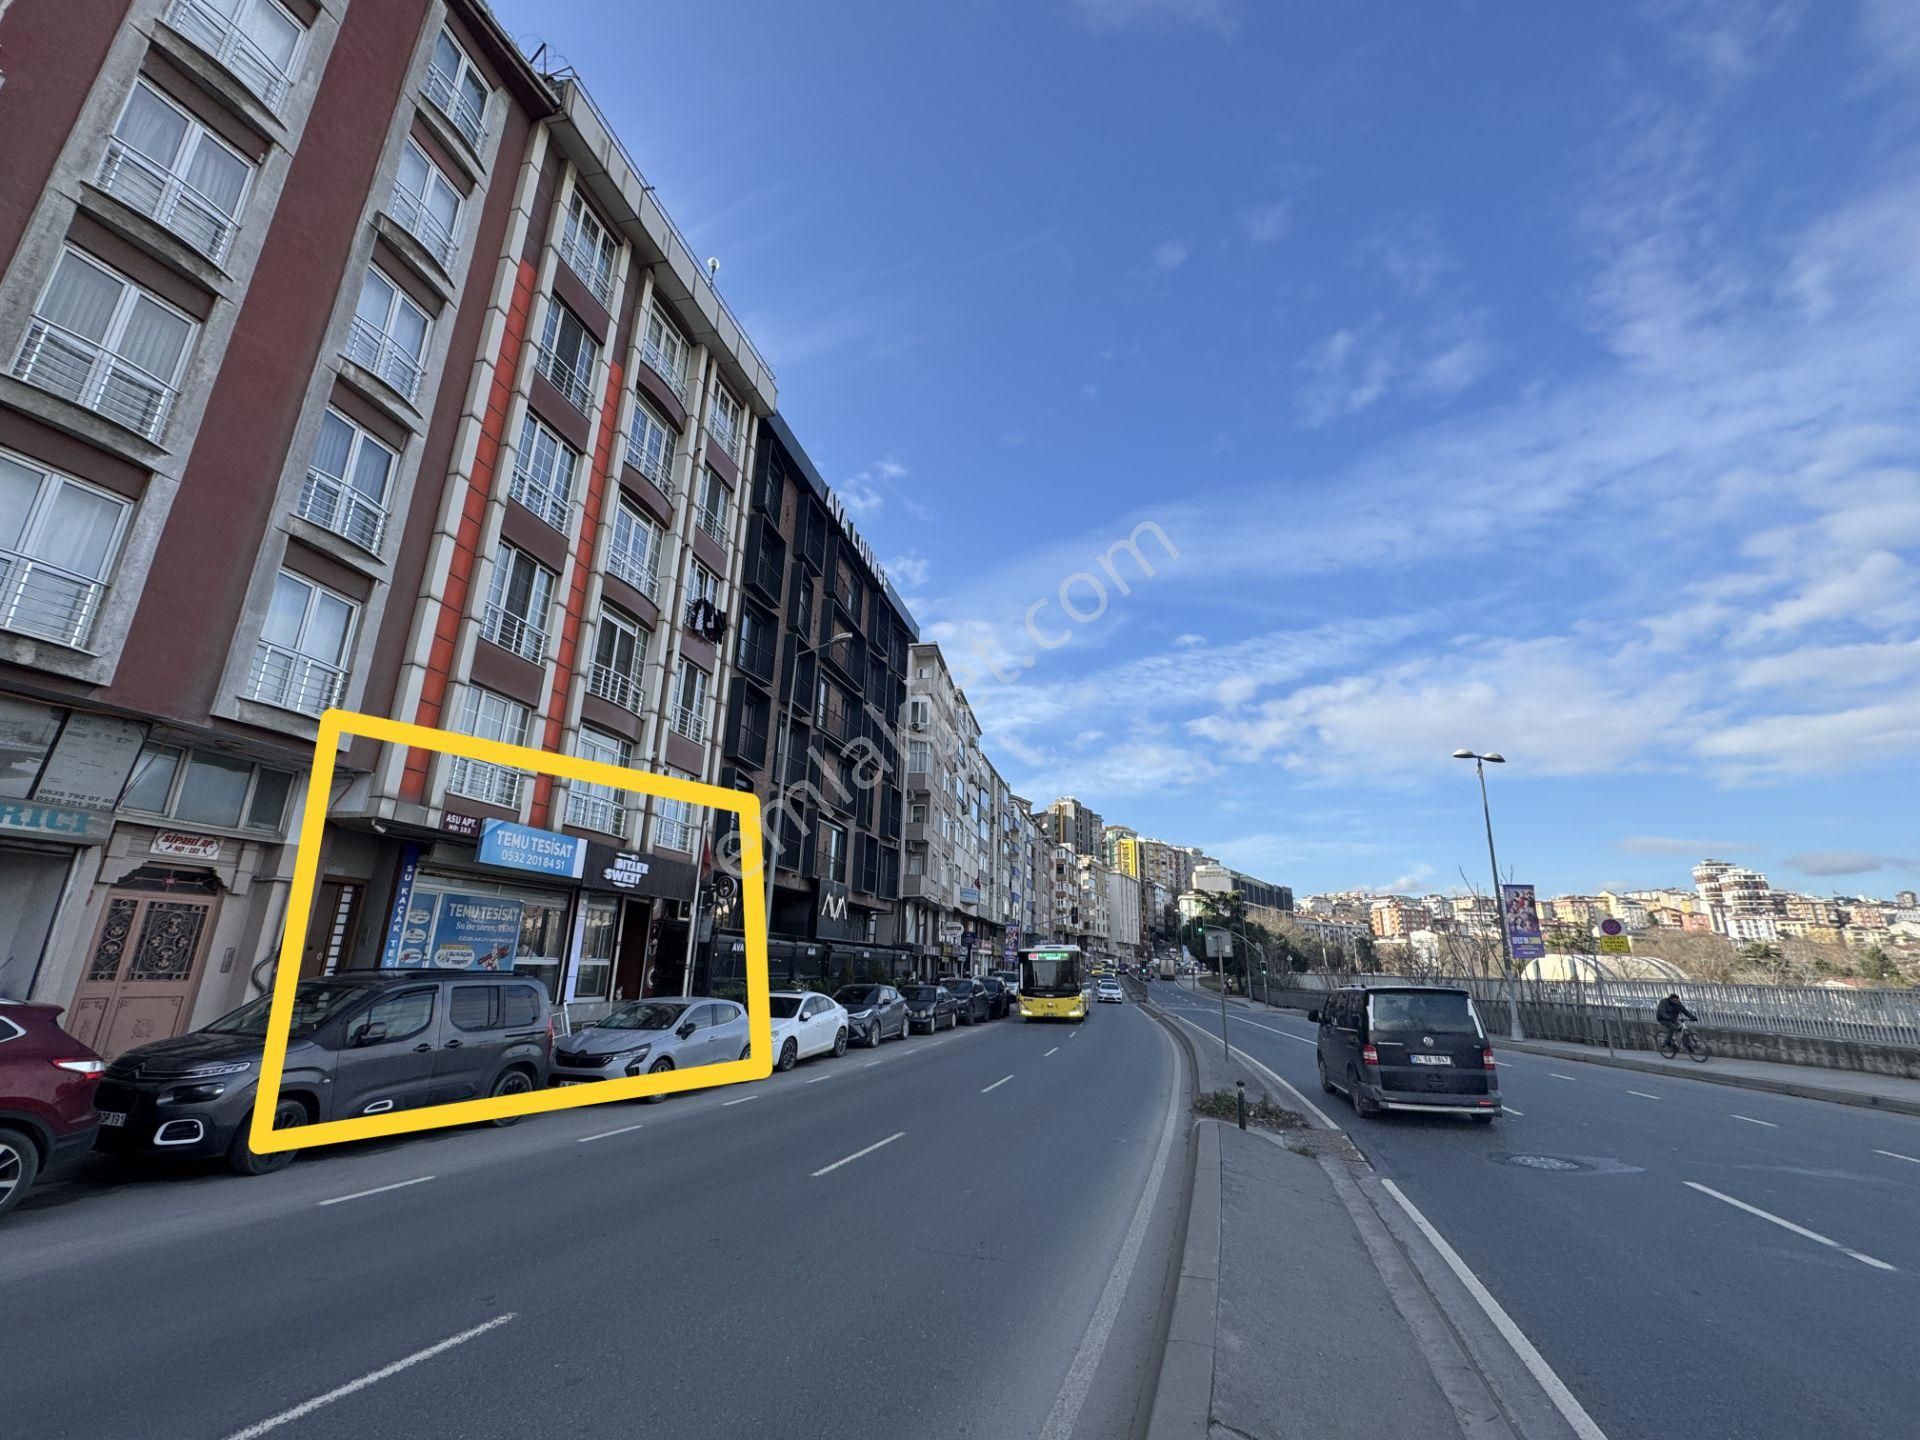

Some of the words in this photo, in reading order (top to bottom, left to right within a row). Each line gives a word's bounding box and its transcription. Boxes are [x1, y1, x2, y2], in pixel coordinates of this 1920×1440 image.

[851, 521, 889, 594] LOUNGE
[446, 814, 461, 825] ASU
[462, 818, 476, 828] APT.
[496, 830, 530, 850] TEMU
[531, 838, 574, 858] TESİSAT
[502, 849, 525, 864] 0532
[404, 865, 414, 882] SU
[603, 868, 642, 885] SWEET
[392, 888, 408, 932] KAÇAK
[450, 903, 478, 918] TEMU
[478, 905, 520, 922] TESİSAT
[732, 943, 744, 952] AVA
